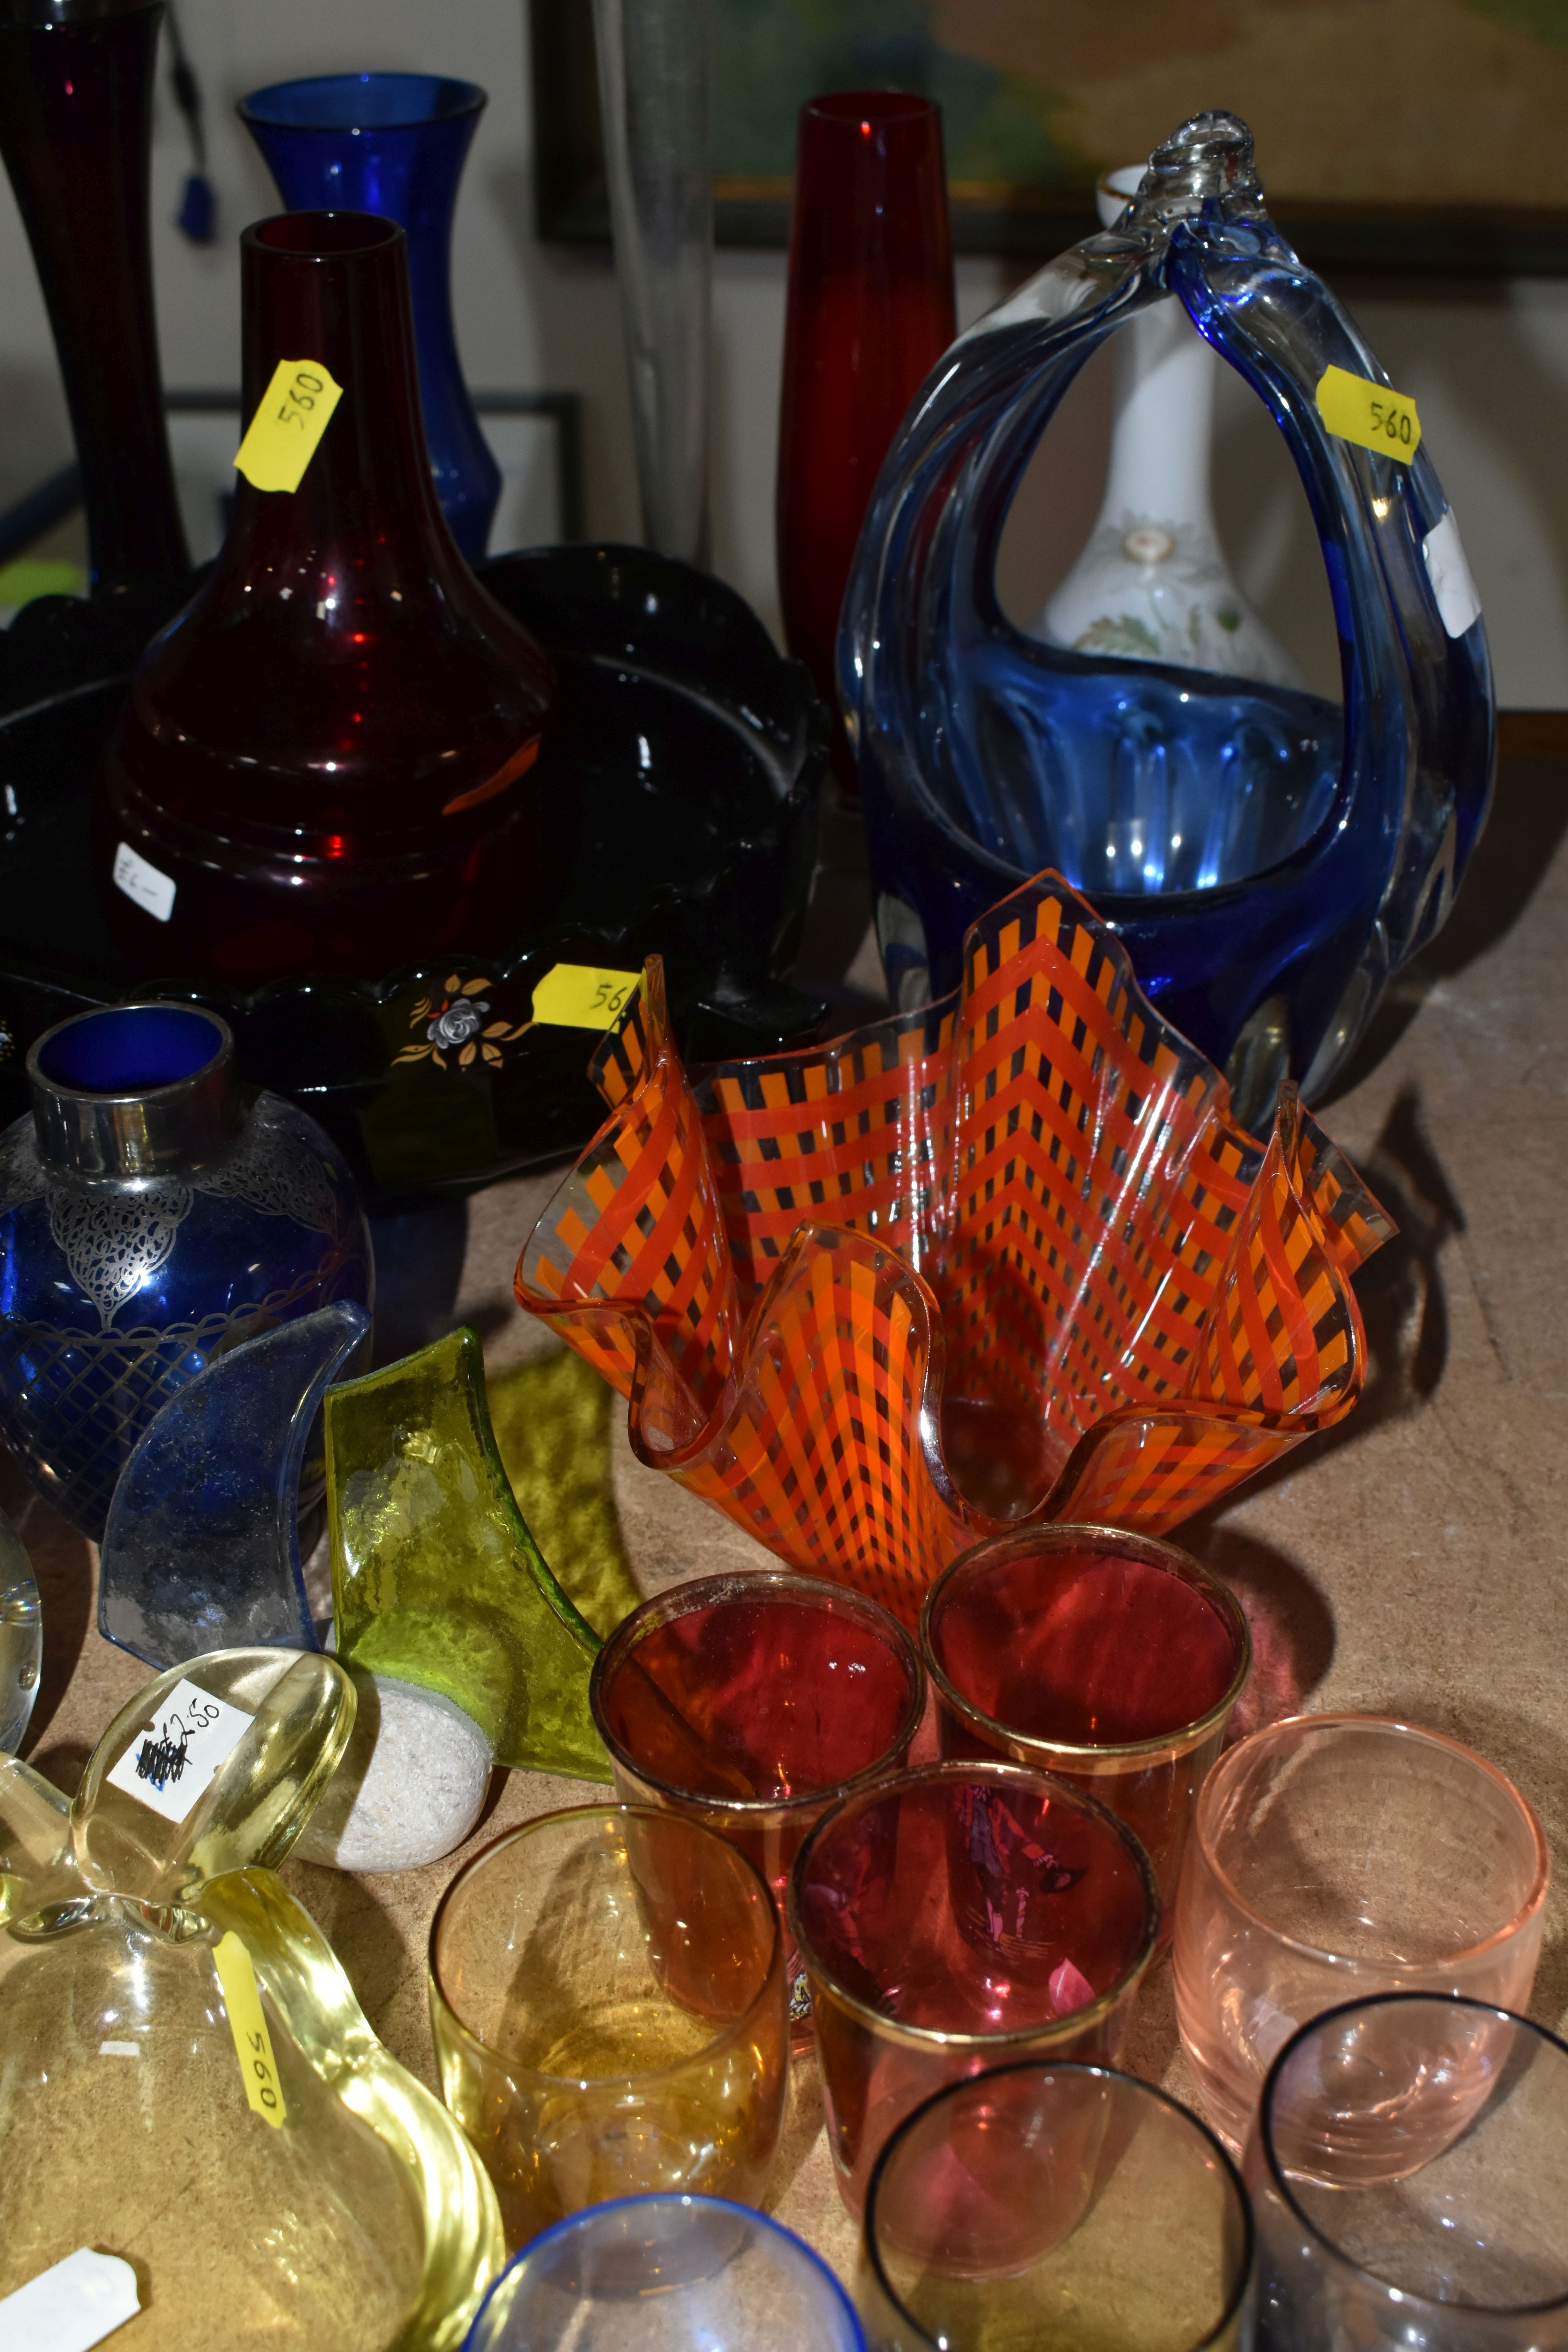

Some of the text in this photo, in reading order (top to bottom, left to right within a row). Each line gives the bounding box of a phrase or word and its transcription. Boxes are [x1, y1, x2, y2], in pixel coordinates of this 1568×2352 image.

[278, 373, 323, 430] 560
[1371, 401, 1411, 445] 560
[247, 2031, 277, 2109] 560
